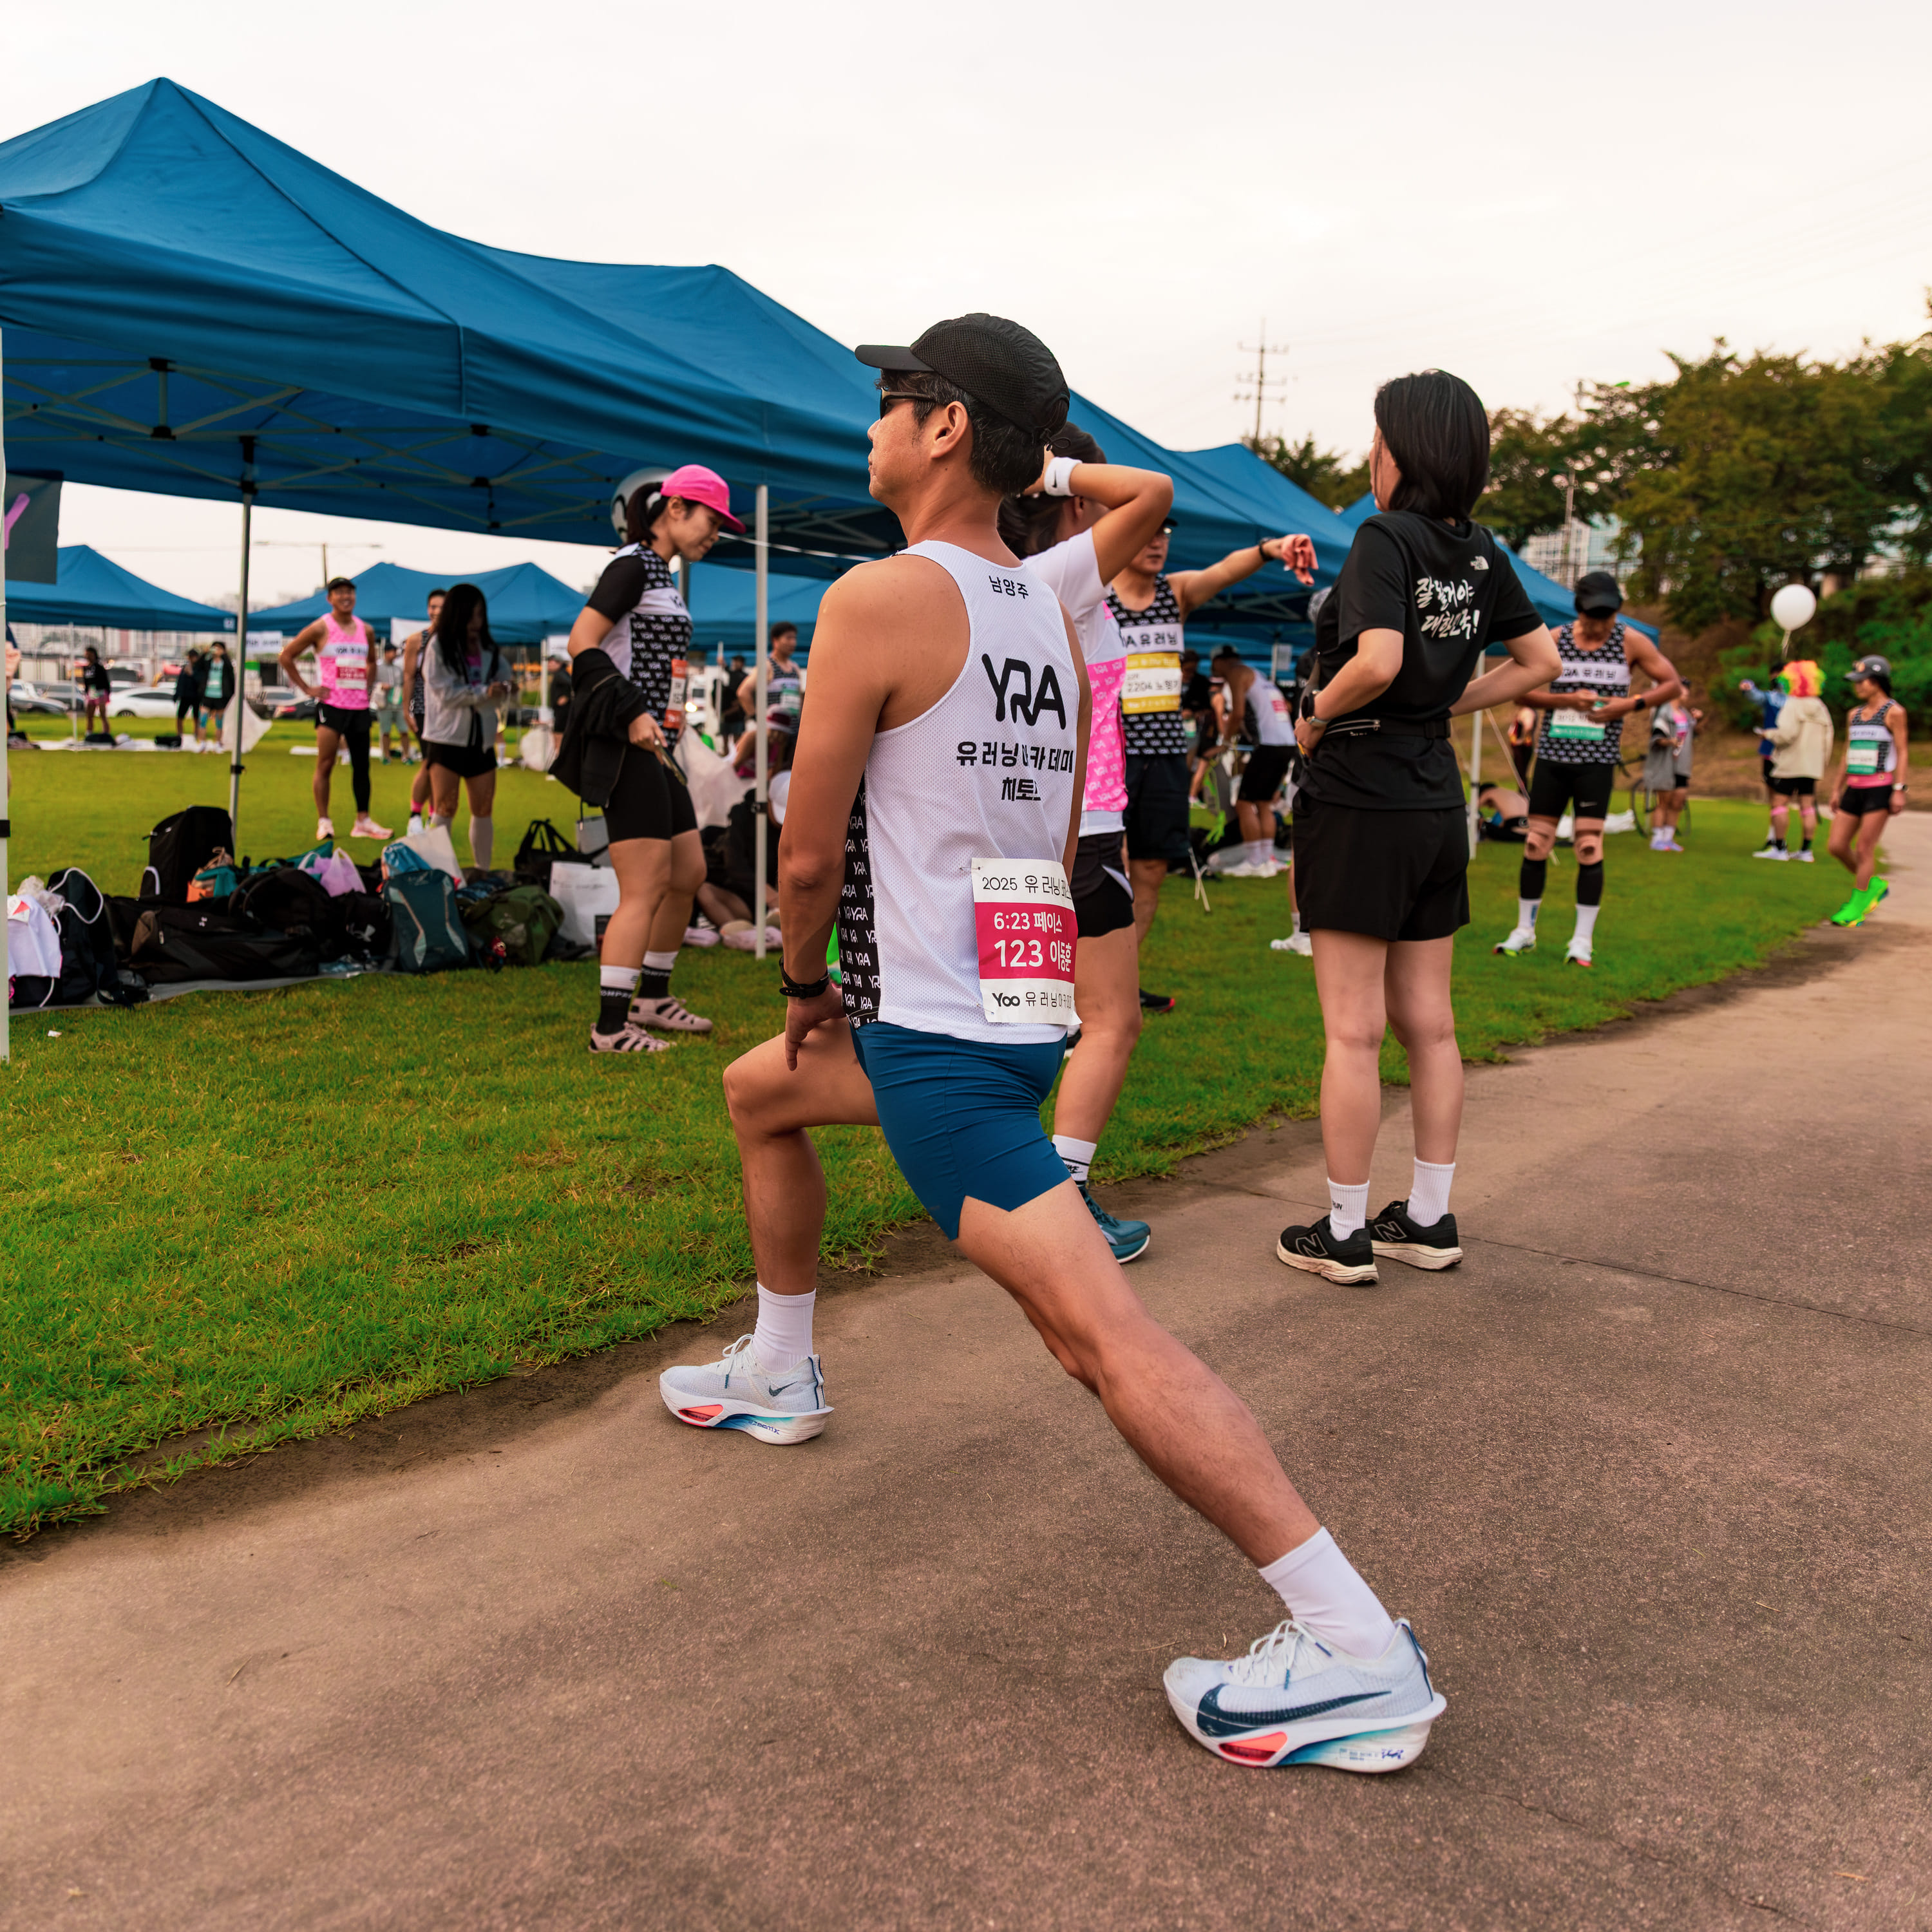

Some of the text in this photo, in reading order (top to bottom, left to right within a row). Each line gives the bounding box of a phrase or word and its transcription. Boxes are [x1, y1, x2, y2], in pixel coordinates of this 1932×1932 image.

[989, 576, 1028, 600] 남양주
[981, 654, 1066, 730] YRA
[982, 877, 1018, 891] 2025
[851, 907, 869, 921] YRA
[994, 911, 1063, 934] 6:23 페이스
[855, 952, 871, 967] YRA
[994, 940, 1072, 972] 123 이동훈
[868, 975, 880, 989] YR
